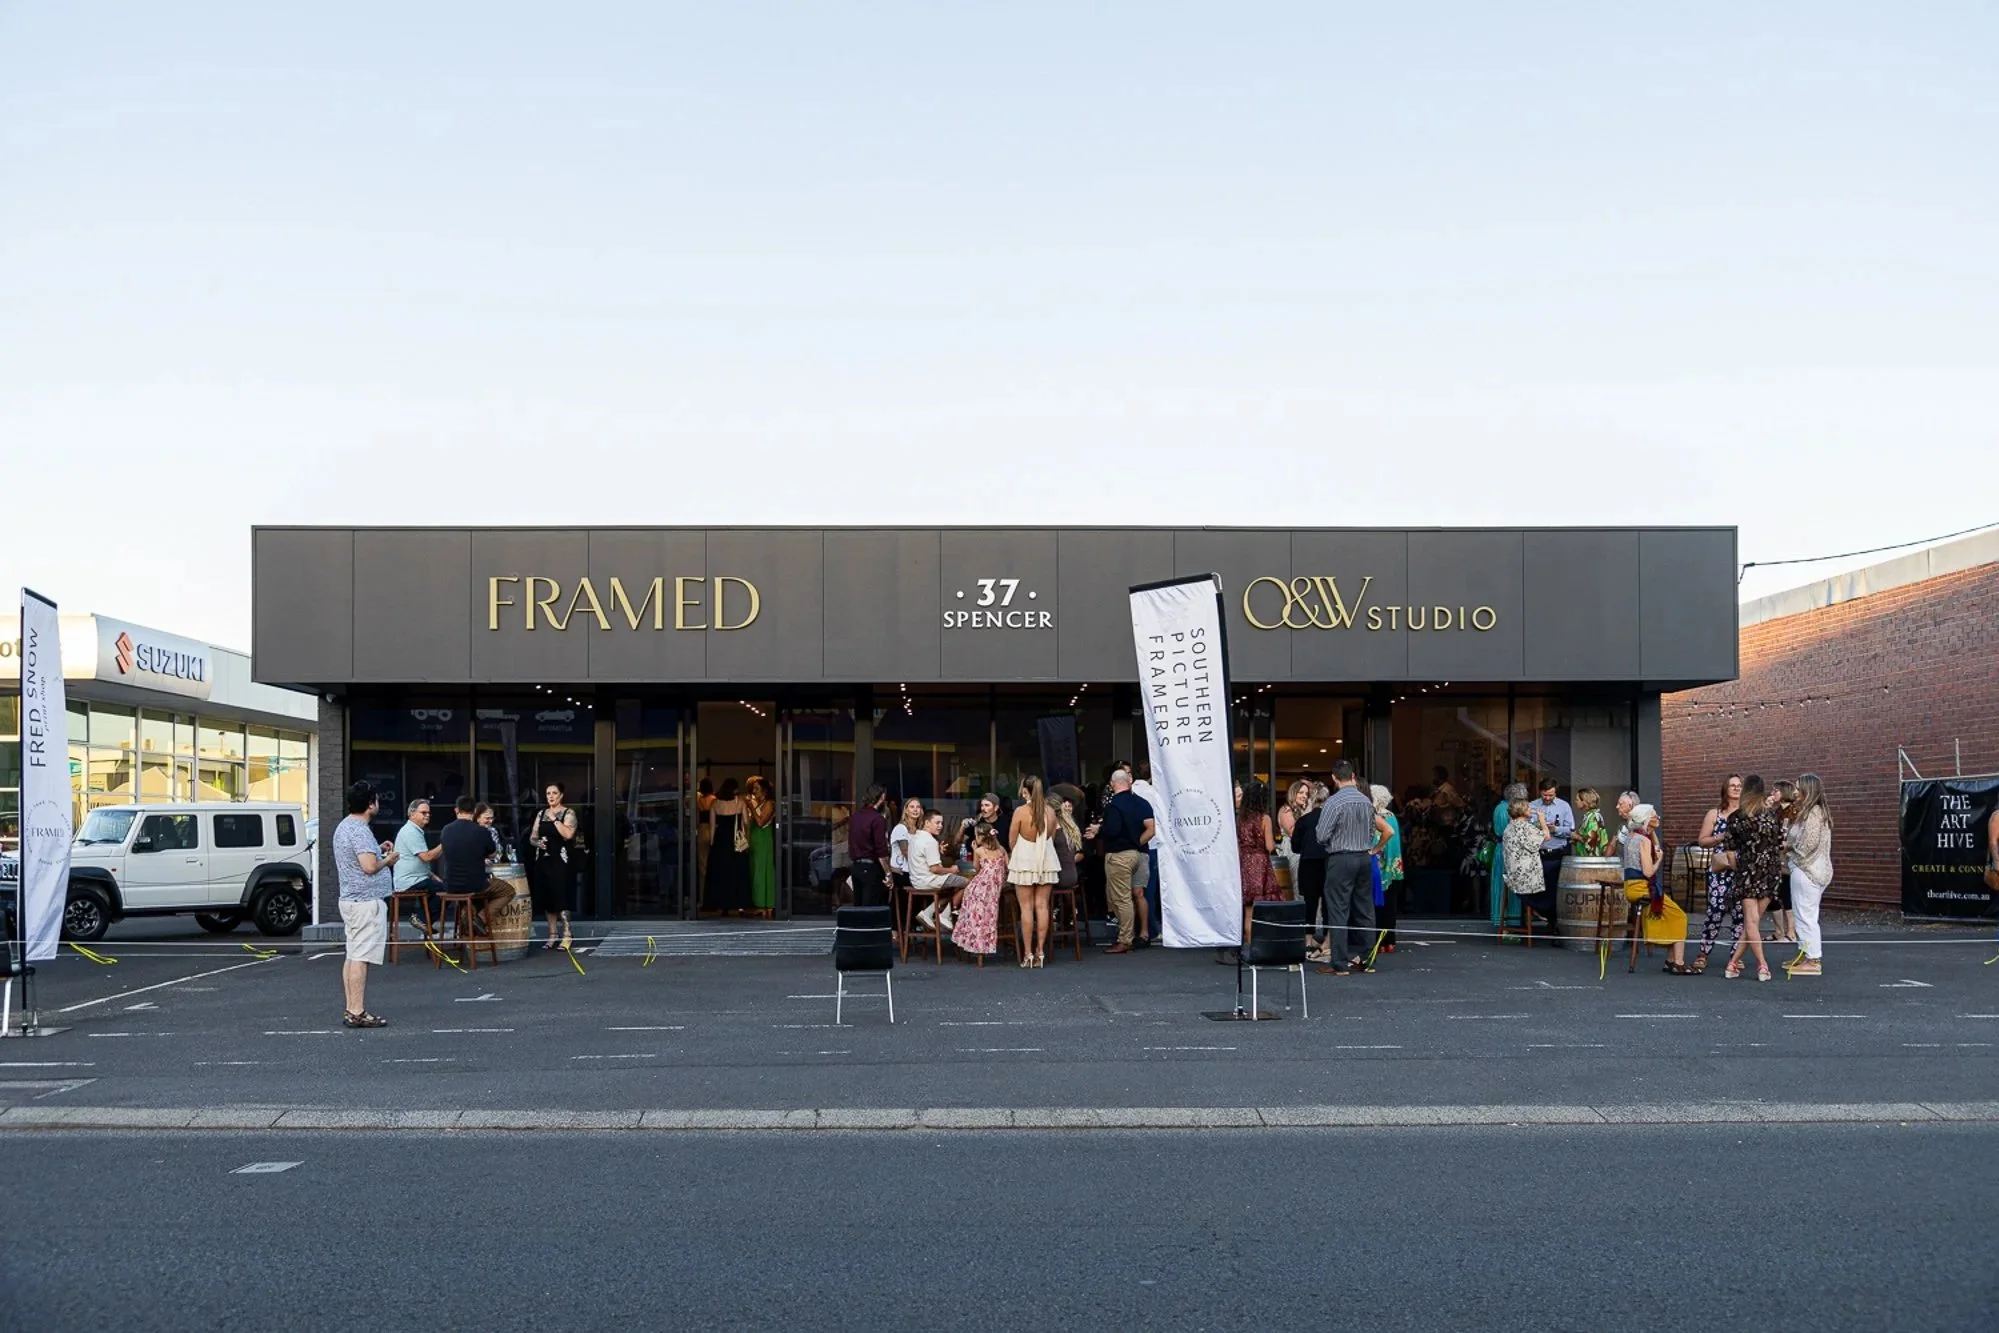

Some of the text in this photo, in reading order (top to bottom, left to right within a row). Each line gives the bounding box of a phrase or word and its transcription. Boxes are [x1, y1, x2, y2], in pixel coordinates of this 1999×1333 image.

[488, 576, 760, 630] FRAMED
[976, 578, 1020, 606] 37
[1243, 576, 1497, 630] O&W STUDIO
[943, 610, 1053, 628] SPENCER
[136, 643, 205, 682] SUZUKI
[27, 627, 47, 768] FRED SNOW
[1149, 635, 1170, 747] FRAMERS
[1170, 632, 1192, 744] PICTURE
[1190, 627, 1213, 742] SOUTHERN
[1940, 794, 1971, 810] THE
[1940, 813, 1971, 829] ART
[1937, 832, 1974, 848] HIVE
[1911, 864, 1946, 873] CREATE
[1959, 865, 1985, 874] CONN
